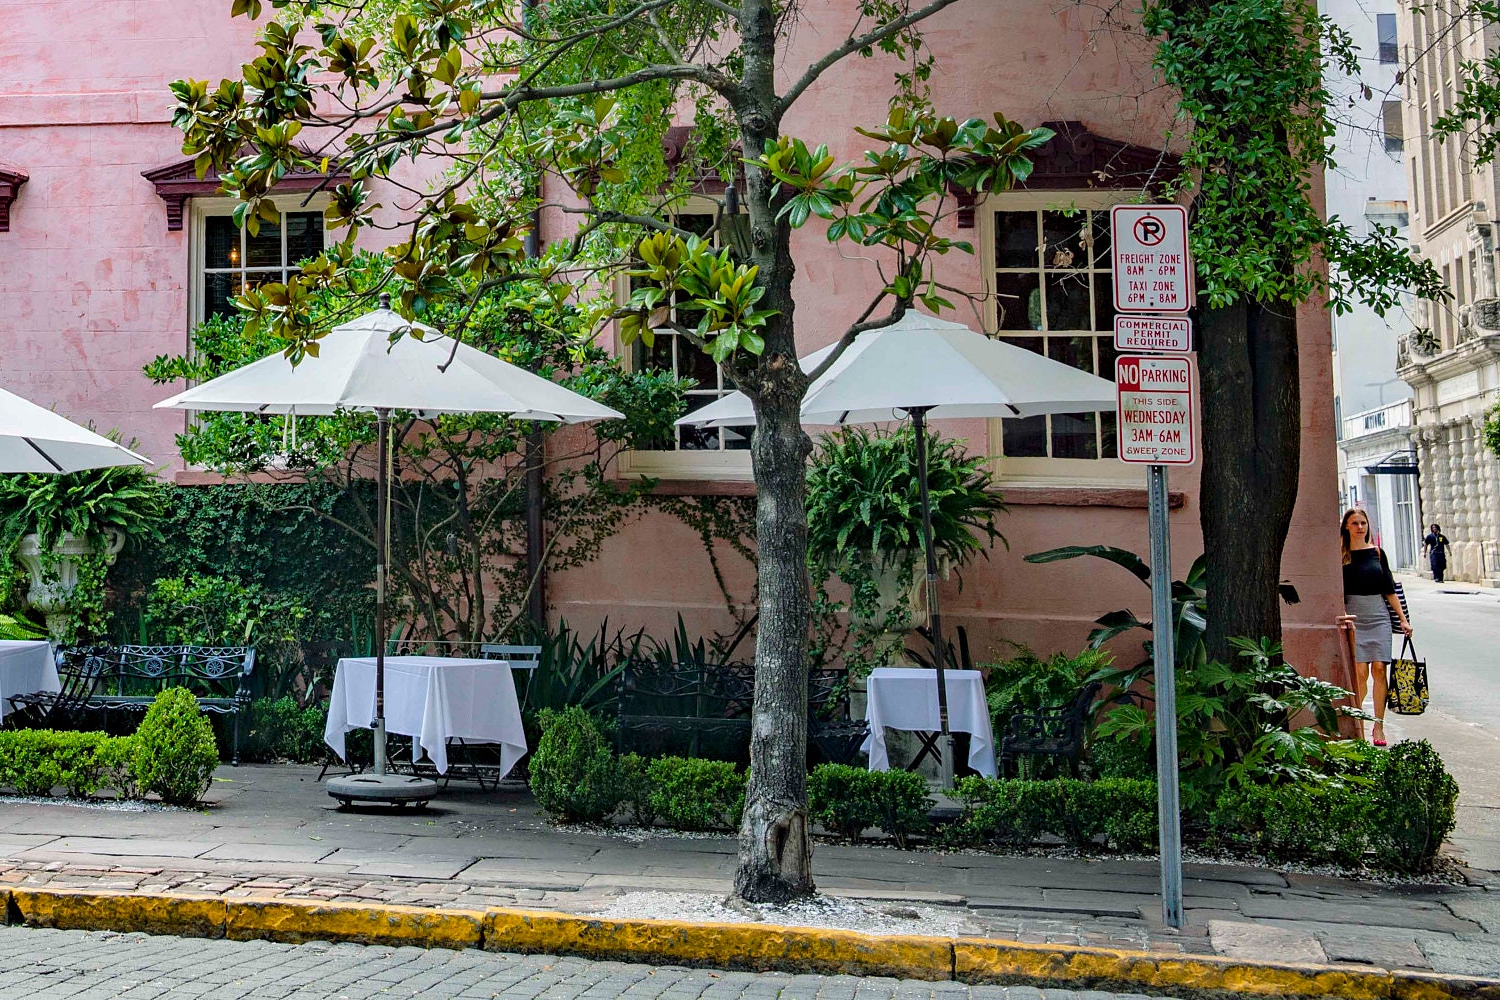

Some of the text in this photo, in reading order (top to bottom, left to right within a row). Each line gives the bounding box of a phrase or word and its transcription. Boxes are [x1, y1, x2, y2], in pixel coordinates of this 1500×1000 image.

[1120, 254, 1181, 264] FREIGHT ZONE
[1126, 265, 1144, 275] 8AM
[1158, 266, 1176, 275] 6PM
[1129, 281, 1175, 291] TAXI ZONE
[1128, 293, 1145, 303] 6PM
[1159, 293, 1177, 303] 8AM
[1119, 320, 1185, 331] COMMERCIAL
[1133, 329, 1171, 339] PERMIT
[1127, 337, 1178, 347] REQUIRED
[1119, 364, 1187, 385] NO PARKING
[1133, 397, 1177, 406] THIS SIDE
[1124, 410, 1186, 425] WEDNESDAY
[1126, 446, 1187, 456] SWEEP ZONE
